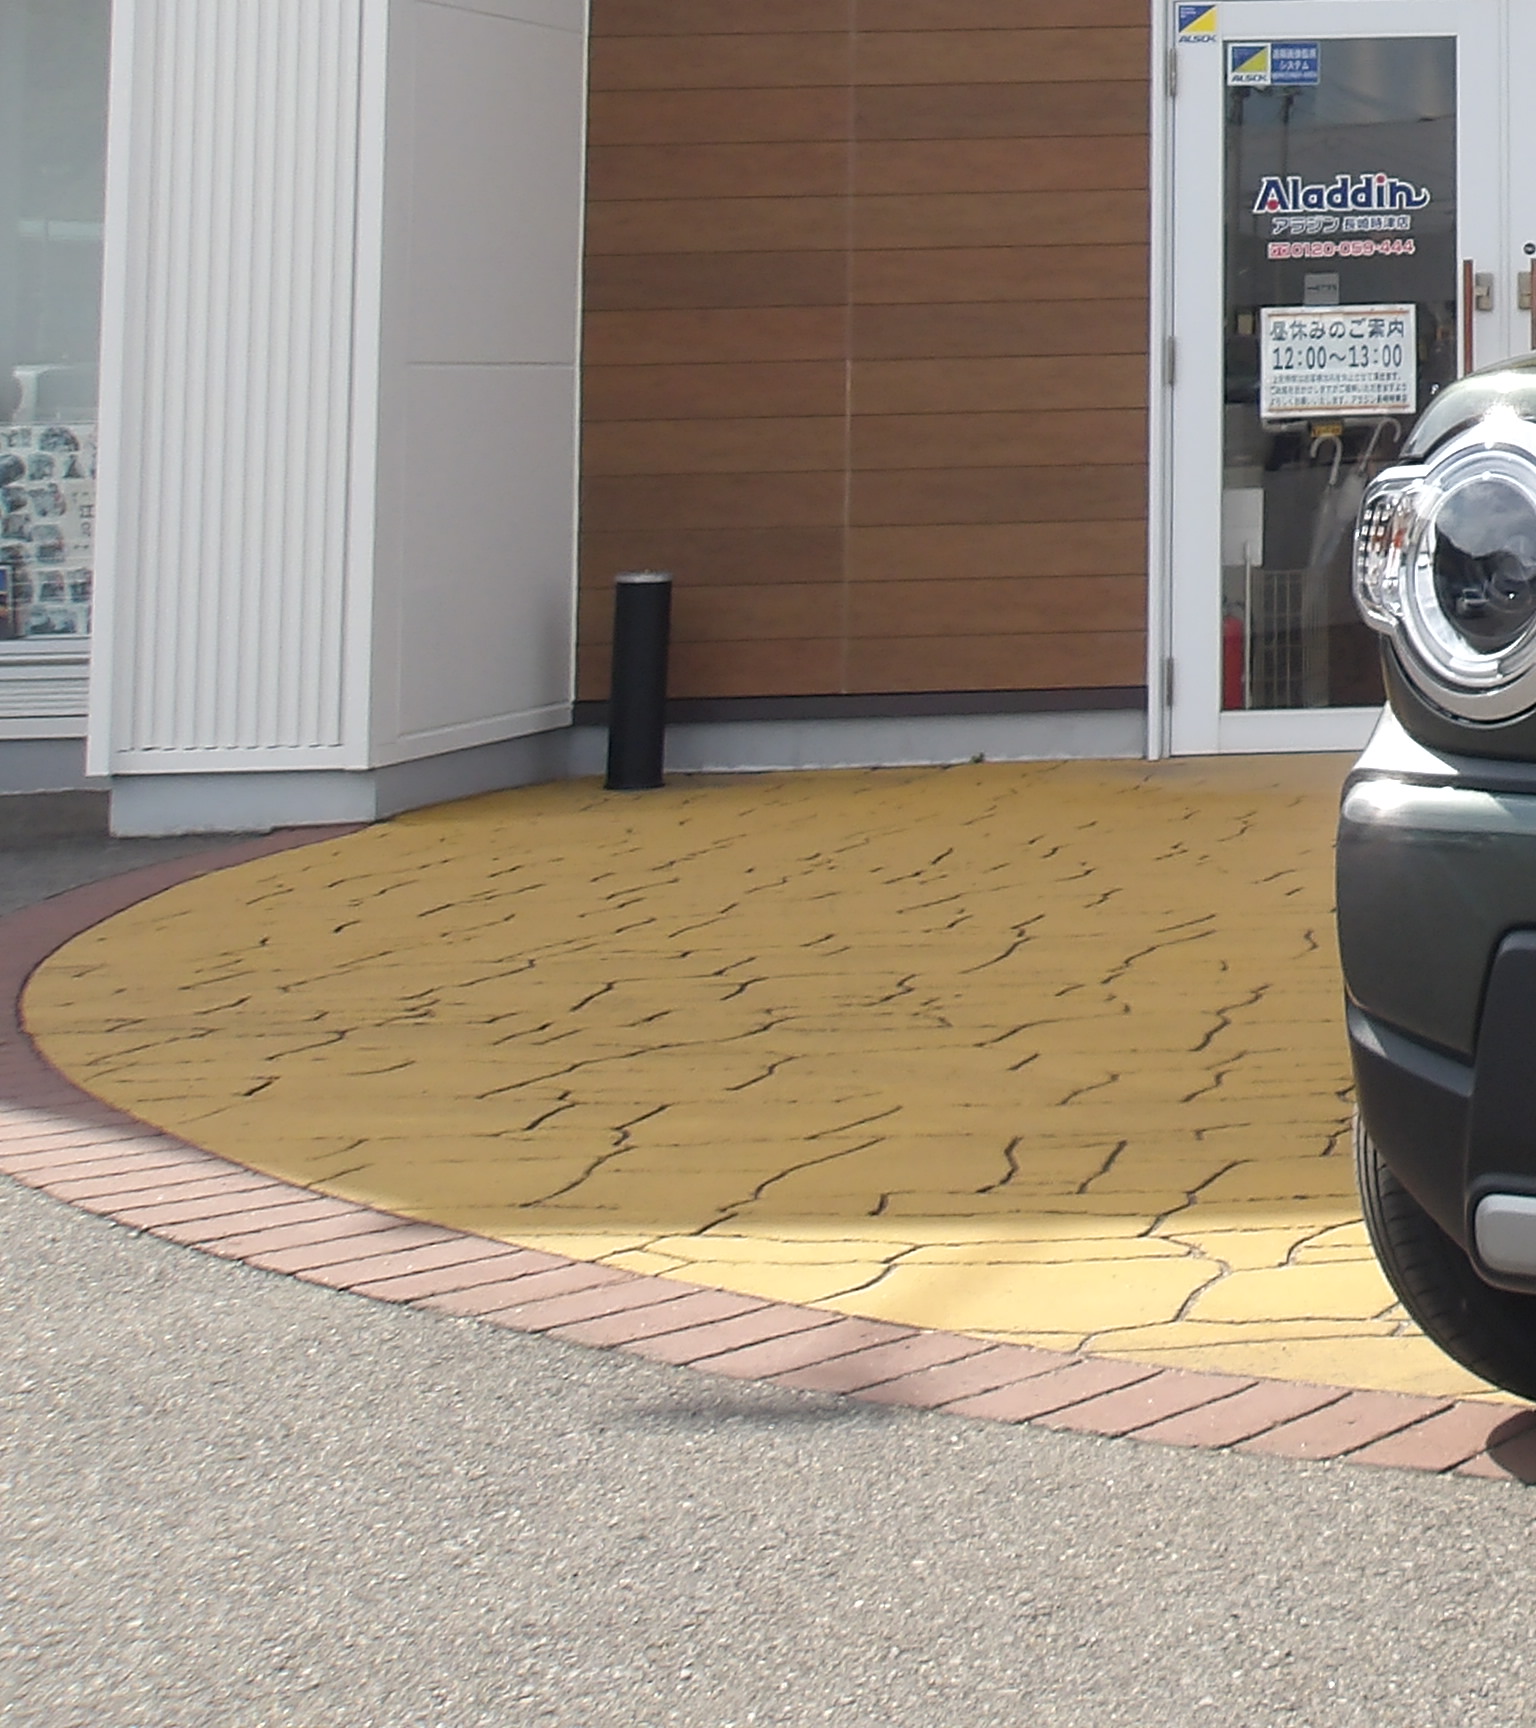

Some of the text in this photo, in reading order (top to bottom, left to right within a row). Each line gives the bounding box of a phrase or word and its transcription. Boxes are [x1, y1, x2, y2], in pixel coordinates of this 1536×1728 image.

[1253, 173, 1431, 213] Aladdin
[1272, 215, 1340, 235] アラジン
[1270, 318, 1405, 341] 昼休みのご案内
